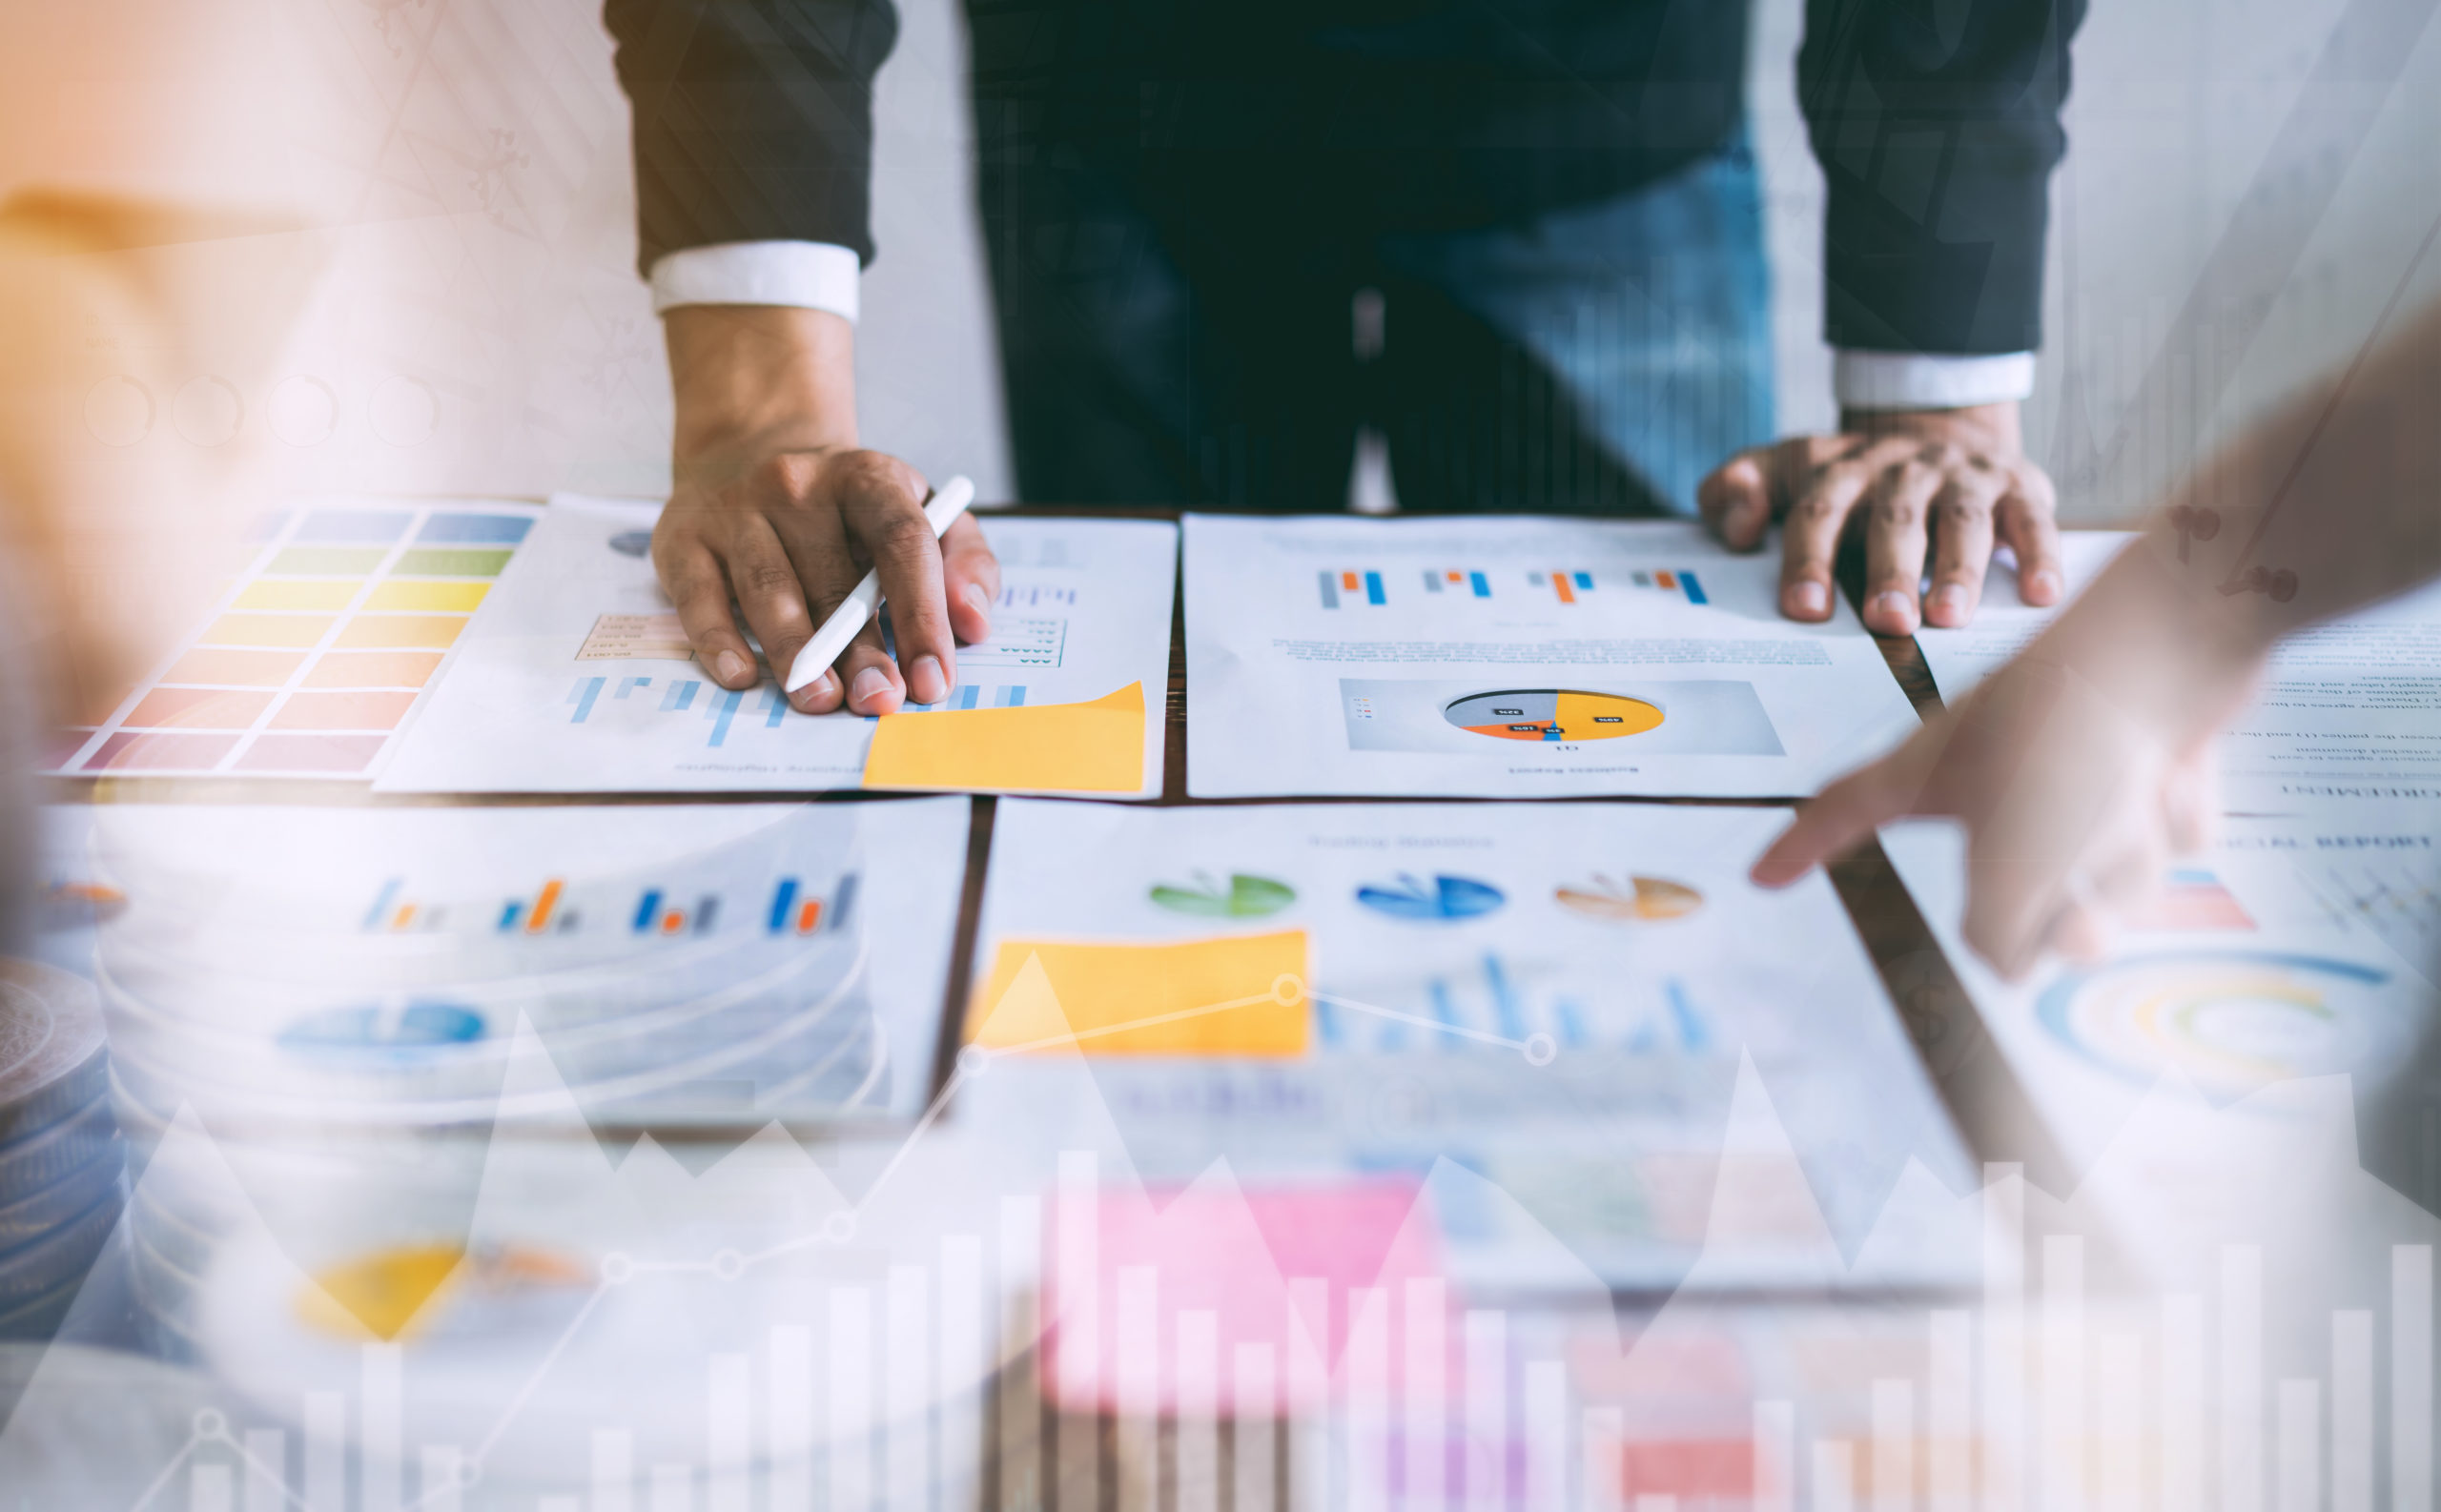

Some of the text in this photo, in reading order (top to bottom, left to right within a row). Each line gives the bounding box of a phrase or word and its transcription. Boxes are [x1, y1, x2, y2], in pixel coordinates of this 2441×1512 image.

[1508, 766, 1639, 775] Business Report
[2315, 835, 2431, 850] REPORT
